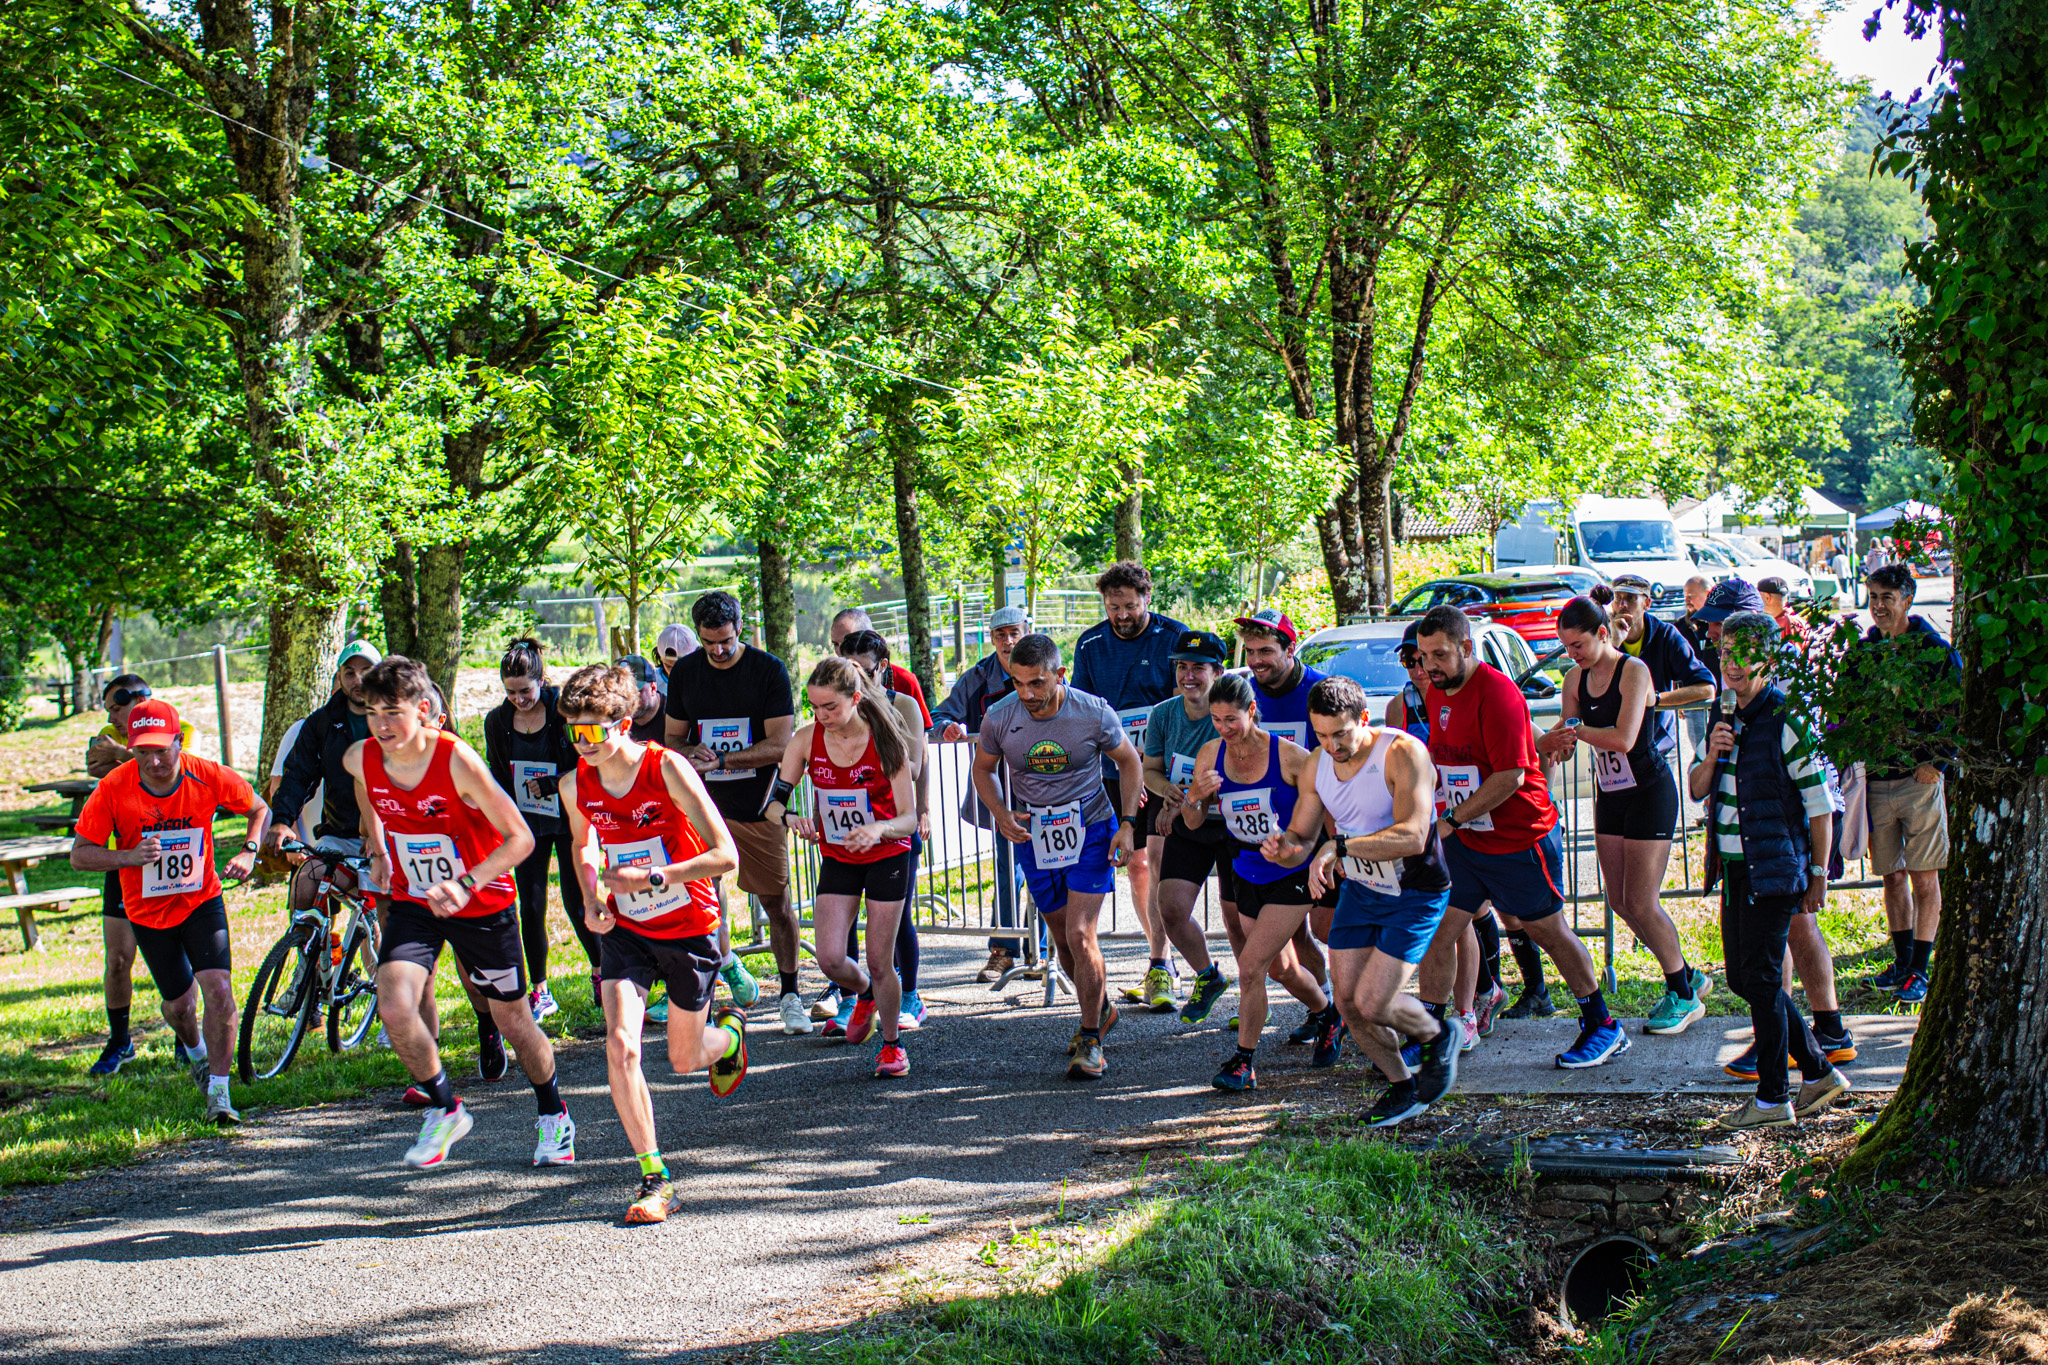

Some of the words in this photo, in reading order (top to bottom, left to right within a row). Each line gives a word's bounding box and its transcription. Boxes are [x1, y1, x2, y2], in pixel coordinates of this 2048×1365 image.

[132, 717, 166, 729] adidas
[828, 809, 866, 831] 149
[1235, 812, 1270, 836] 186
[1040, 826, 1078, 854] 180
[153, 854, 194, 881] 189
[409, 856, 453, 883] 179
[629, 904, 649, 916] Crédit
[656, 895, 680, 909] Mutuel
